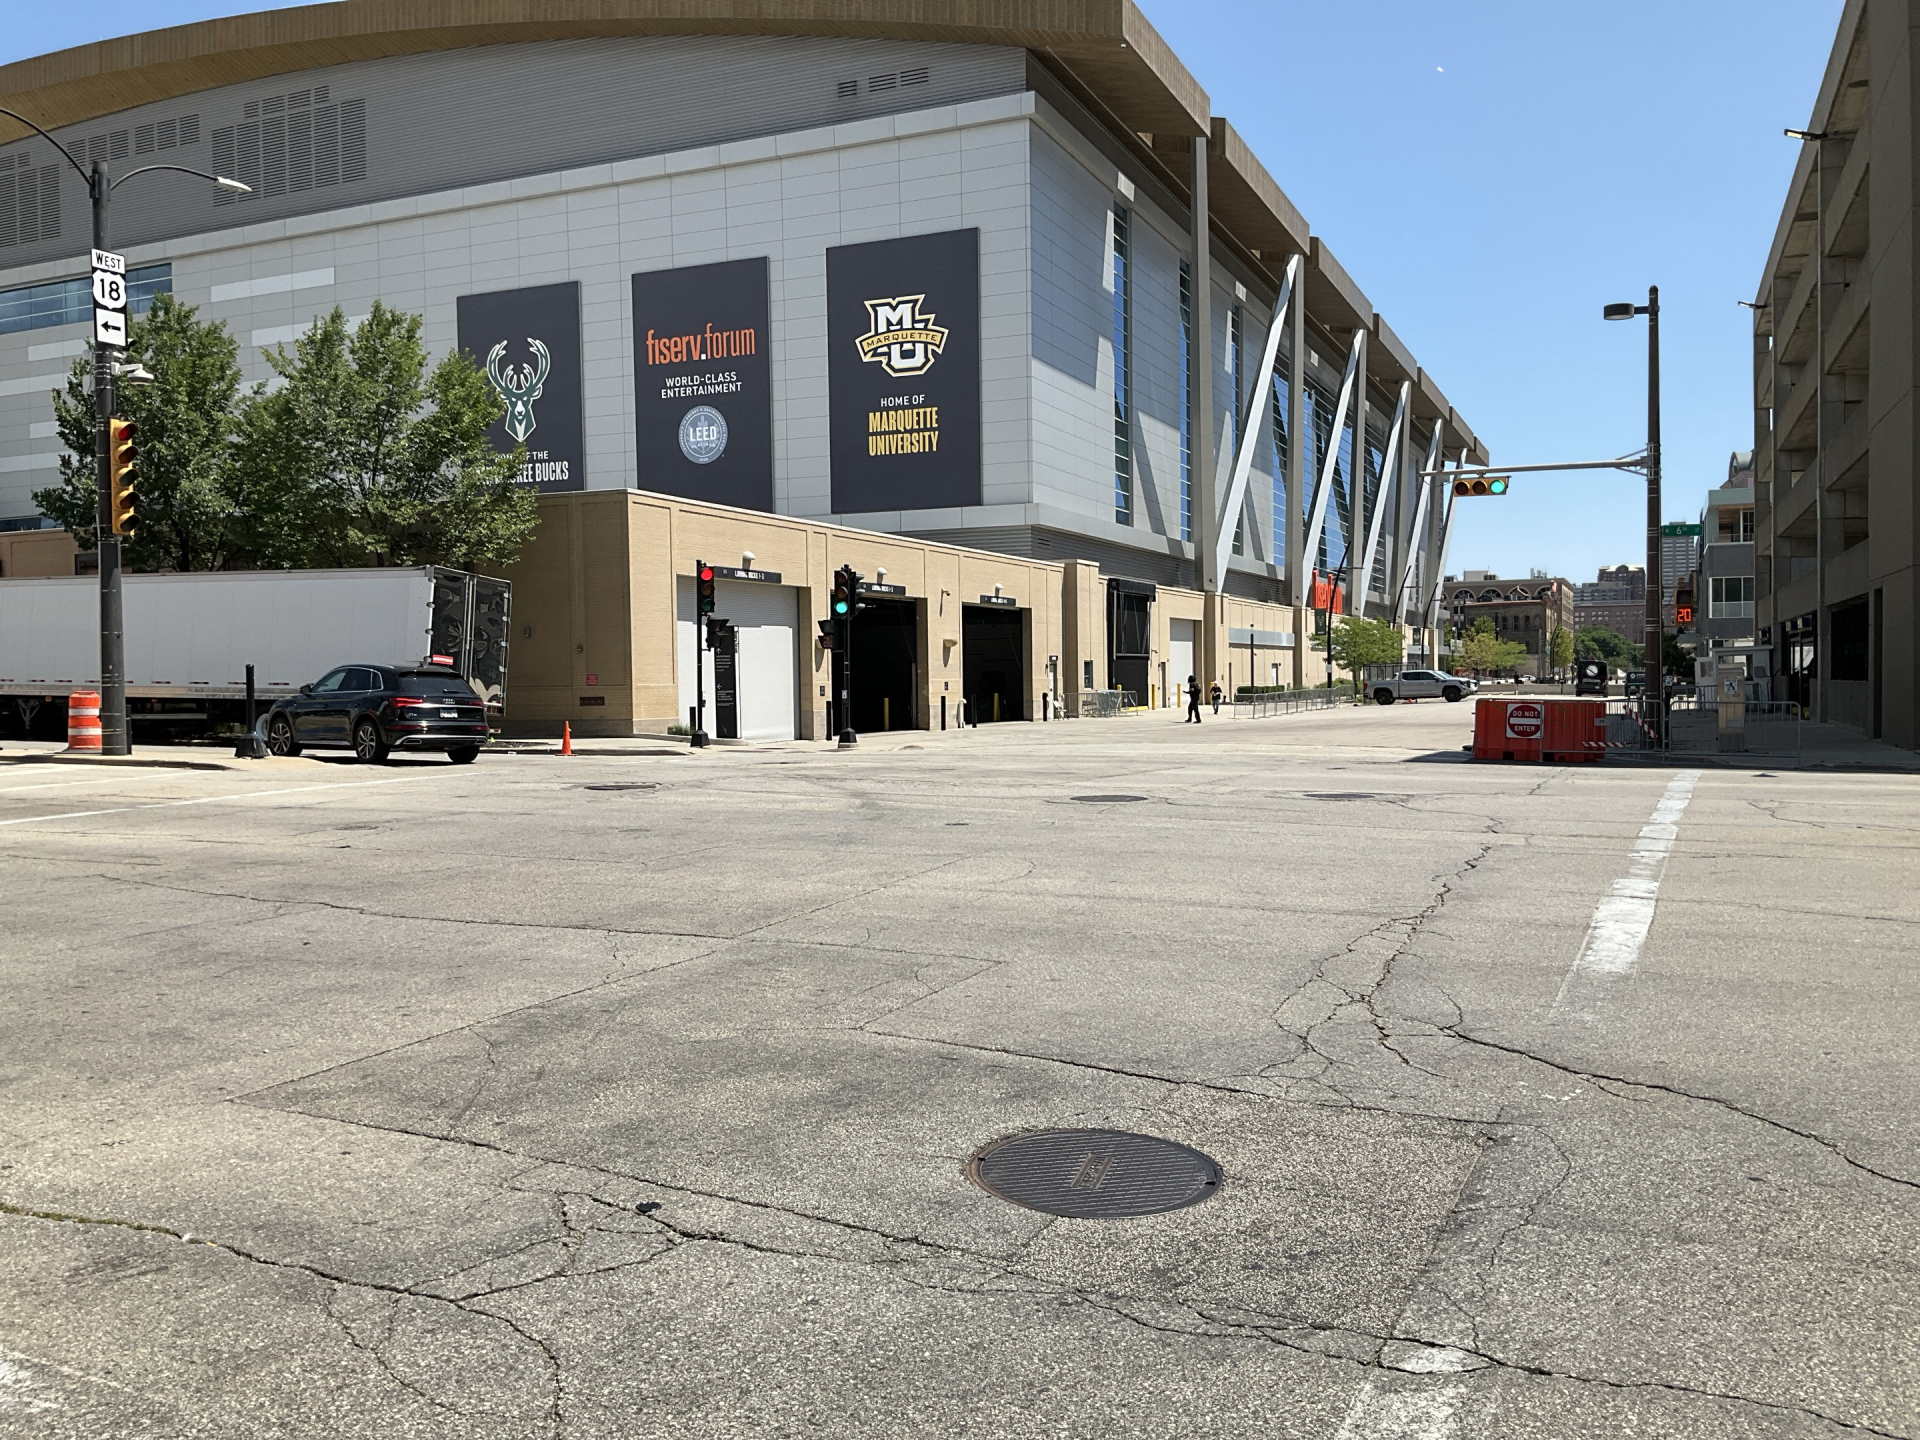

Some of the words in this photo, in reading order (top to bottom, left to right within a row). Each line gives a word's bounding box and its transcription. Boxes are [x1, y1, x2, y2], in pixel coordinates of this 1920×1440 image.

[95, 251, 122, 270] WEST
[99, 277, 121, 302] 18
[866, 332, 938, 348] MARQUETTE
[665, 371, 737, 388] WORLD-CLASS
[661, 382, 742, 399] ENTERTAINMENT
[880, 395, 910, 407] HOME
[912, 394, 926, 405] OF
[868, 407, 939, 433] MARQUETTE
[689, 425, 717, 442] LEED
[868, 430, 939, 456] UNIVERSITY
[532, 450, 549, 460] THE
[535, 460, 569, 482] BUCKS
[1677, 608, 1692, 622] 20
